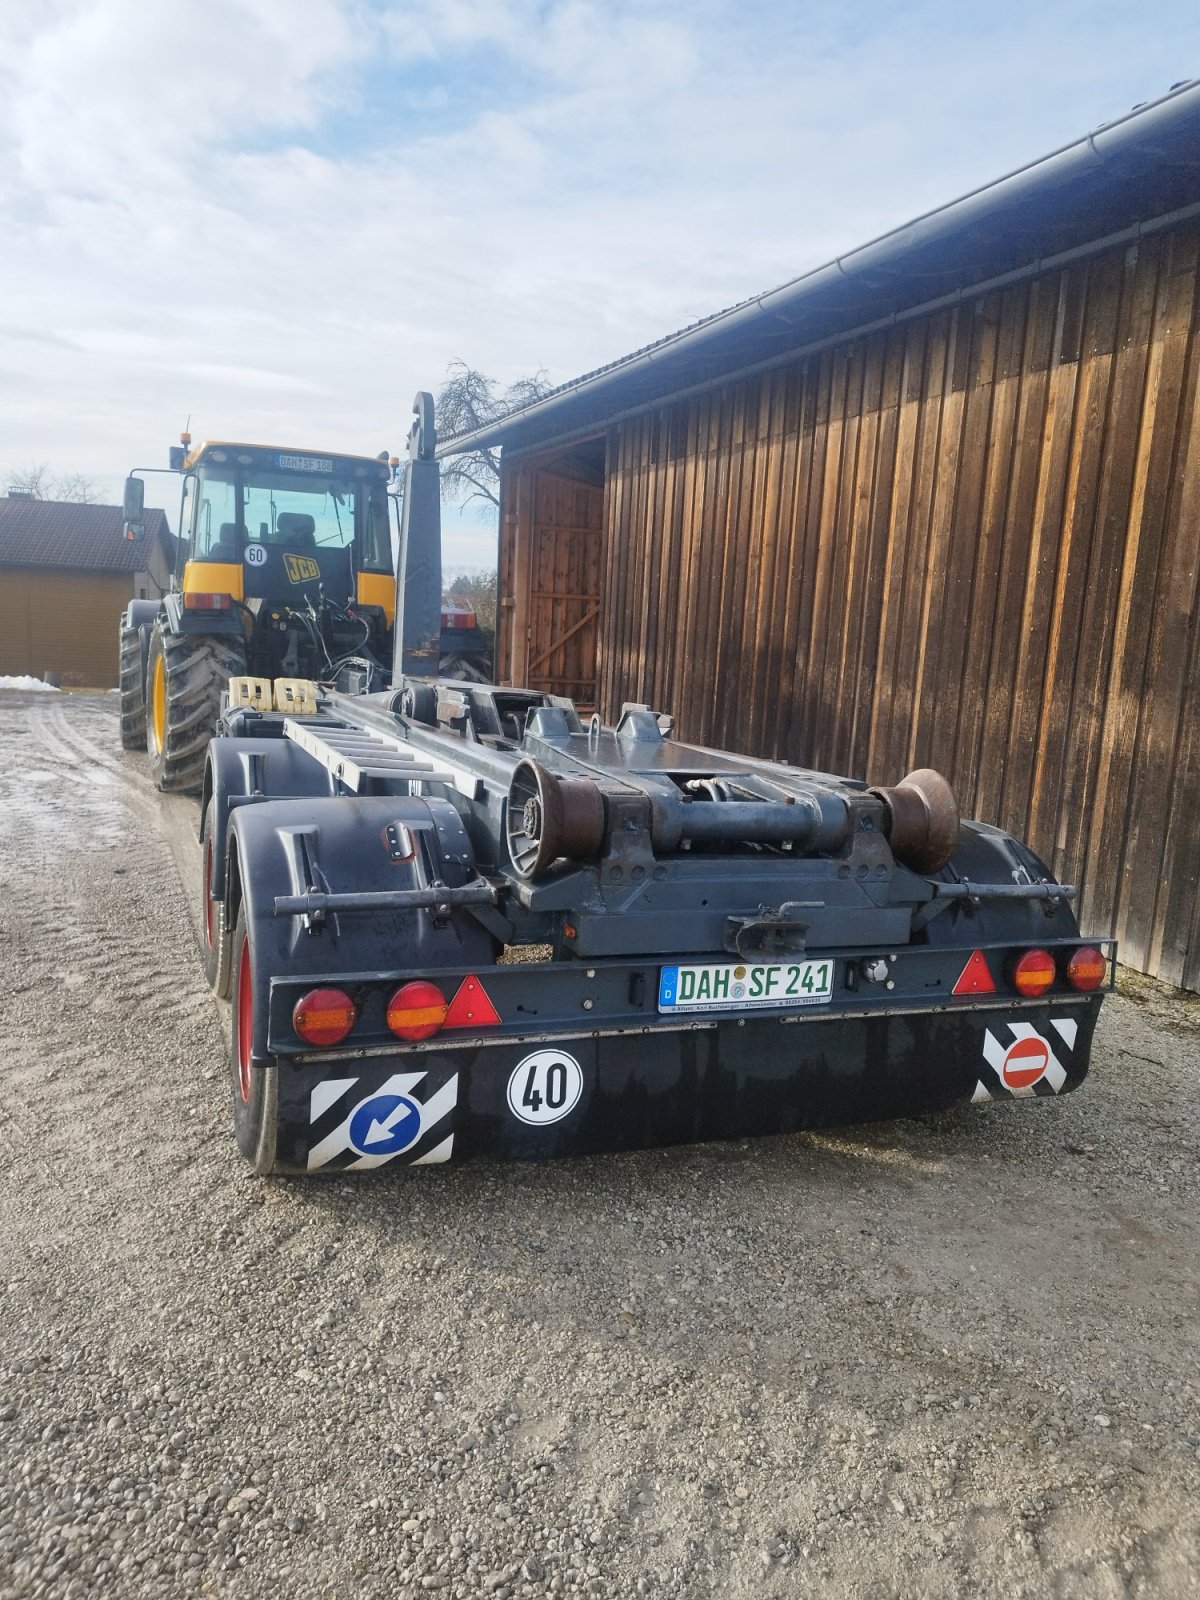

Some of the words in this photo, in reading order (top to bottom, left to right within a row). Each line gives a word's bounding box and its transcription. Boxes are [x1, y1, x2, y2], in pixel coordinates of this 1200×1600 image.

[249, 548, 263, 562] 60
[288, 556, 318, 581] JCB
[664, 989, 672, 999] D
[679, 969, 730, 1000] DAH
[748, 966, 781, 997] SF
[785, 964, 828, 995] 241
[522, 1062, 567, 1112] 40
